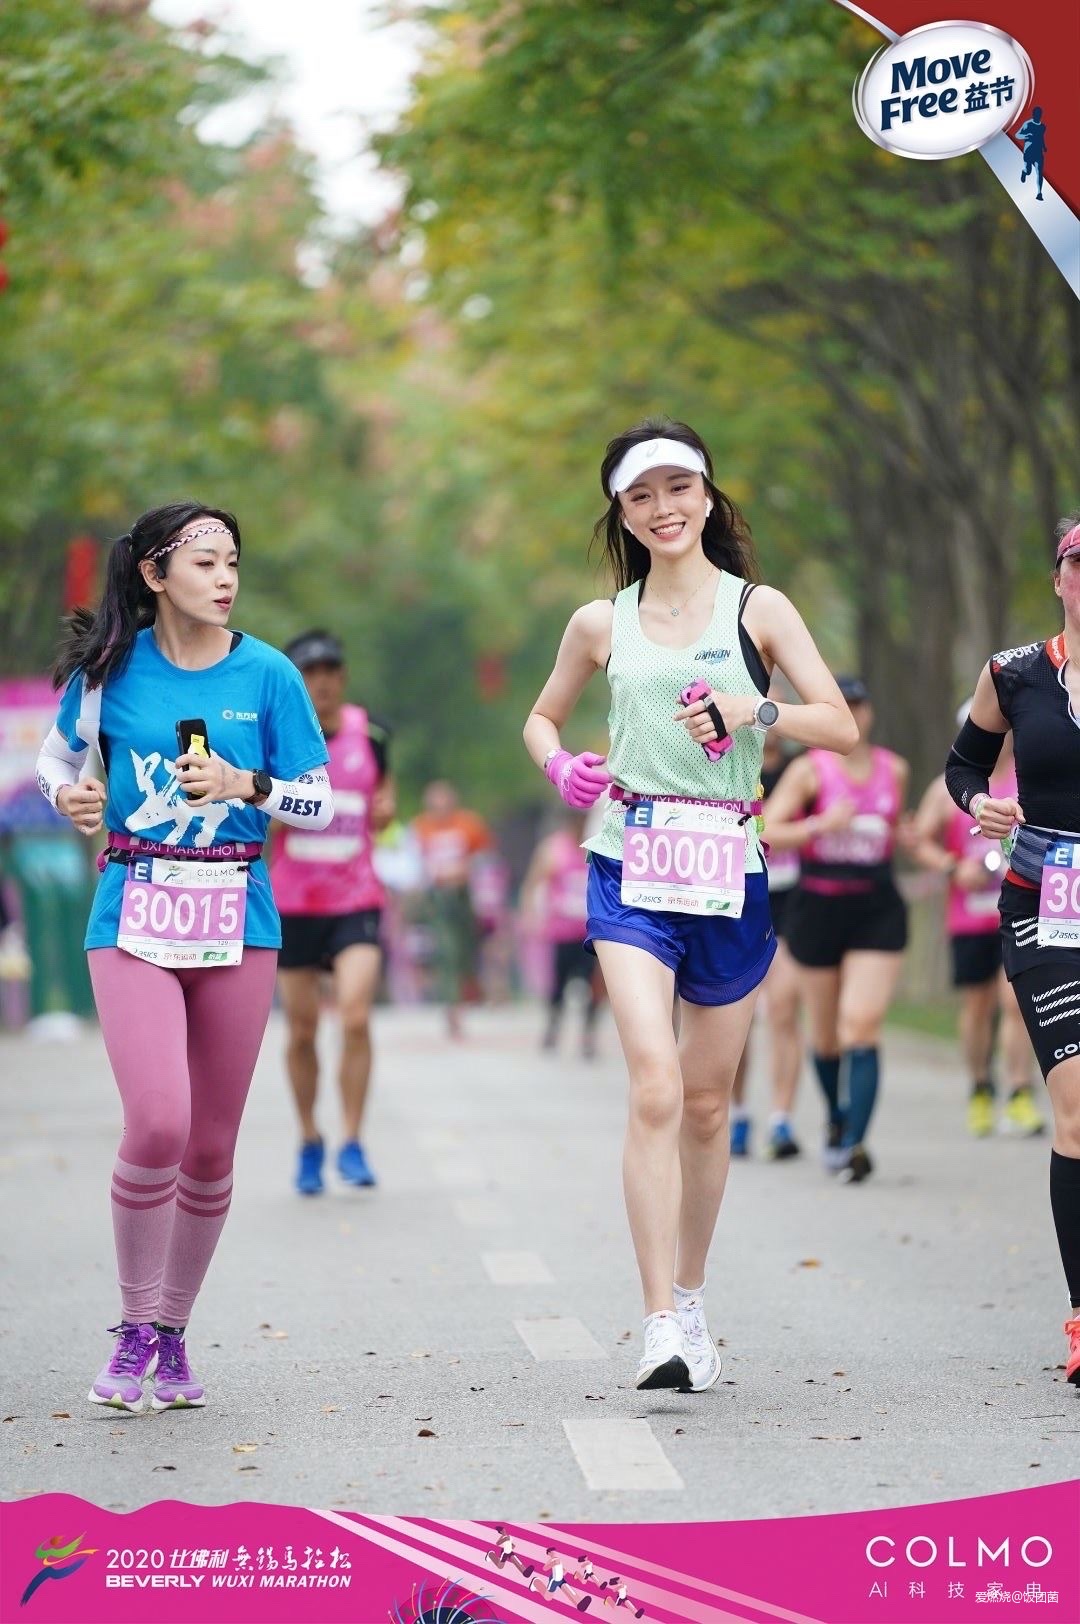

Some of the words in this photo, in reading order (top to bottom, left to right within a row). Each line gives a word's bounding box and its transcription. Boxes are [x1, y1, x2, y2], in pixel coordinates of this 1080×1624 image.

[997, 642, 1039, 667] SPORT
[279, 795, 322, 817] BEST
[634, 807, 650, 825] E
[698, 812, 734, 825] COLMO
[141, 841, 161, 852] UXI
[166, 844, 234, 856] MARATHO
[1055, 847, 1069, 865] E
[628, 832, 733, 885] 30001
[134, 862, 149, 880] E
[197, 868, 235, 877] COLMO
[126, 887, 239, 935] 30015
[1054, 1041, 1080, 1060] CO
